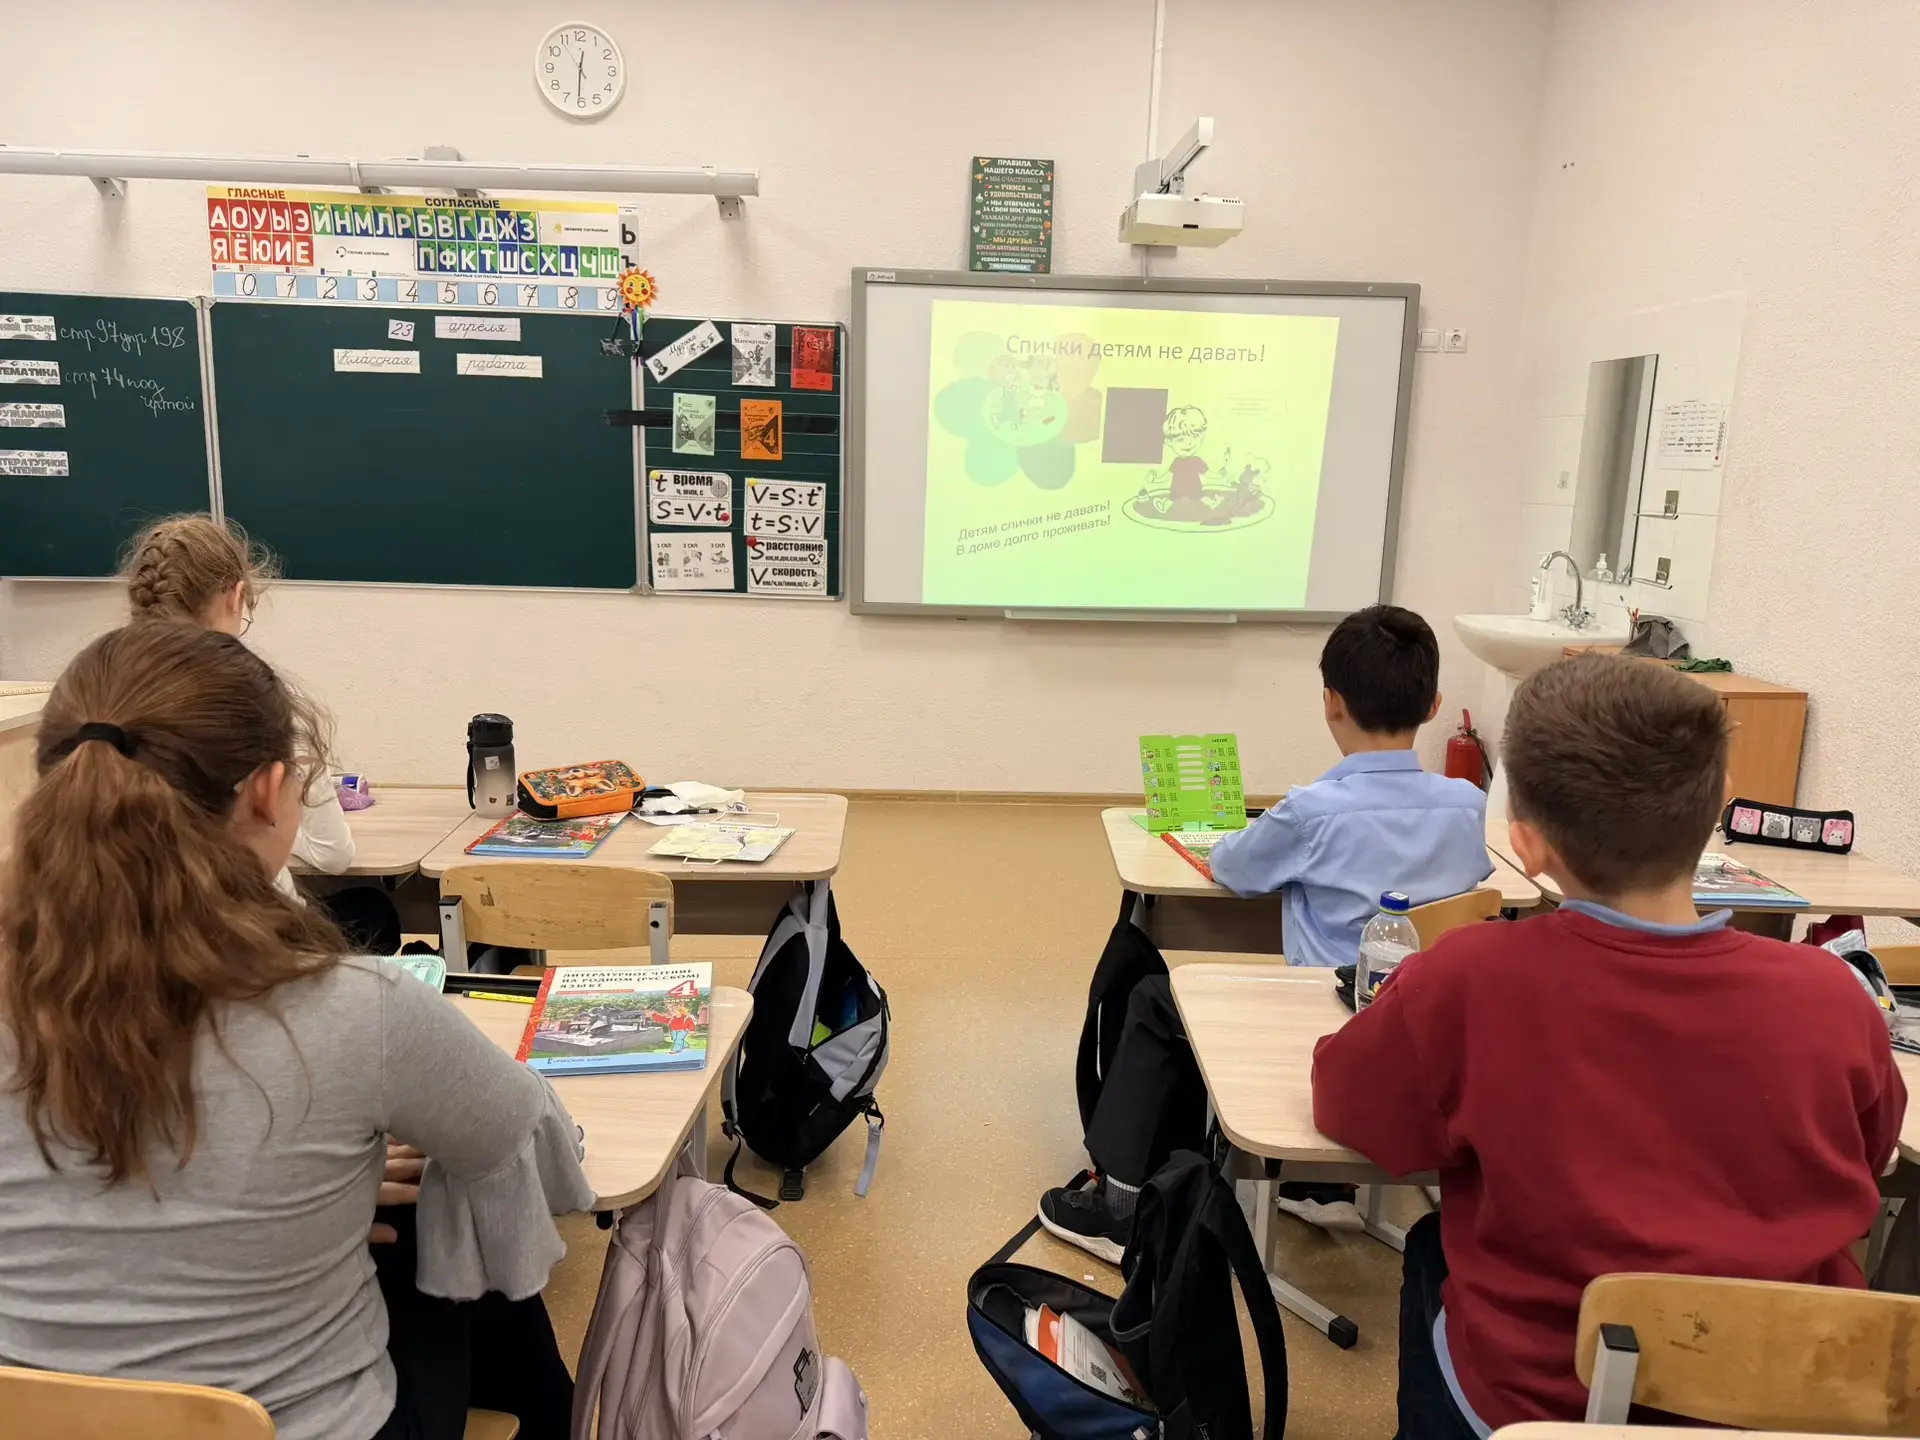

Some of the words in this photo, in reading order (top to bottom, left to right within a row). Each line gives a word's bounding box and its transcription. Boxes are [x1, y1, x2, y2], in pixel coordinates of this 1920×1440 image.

[560, 34, 569, 45] 11
[574, 31, 587, 42] 12
[593, 36, 598, 47] 1
[549, 46, 561, 57] 10
[603, 49, 612, 60] 2
[545, 63, 554, 73] 9
[607, 66, 617, 77] 3
[551, 80, 560, 90] 8
[603, 82, 612, 93] 4
[563, 92, 570, 103] 7
[577, 97, 586, 108] 6
[592, 94, 601, 105] 5
[997, 159, 1032, 167] ПРАВИЛА
[1015, 168, 1045, 176] КЛАССА
[227, 188, 286, 200] ГЛАСНЫЕ
[425, 197, 500, 209] СОГЛАСНЫЕ
[210, 205, 228, 228] А
[231, 207, 248, 229] О
[251, 207, 267, 230] У
[271, 208, 290, 231] Ы
[294, 209, 310, 232] Э
[313, 205, 331, 233] Й
[334, 211, 350, 233] Н
[354, 212, 373, 234] М
[375, 212, 394, 235] Л
[397, 213, 411, 235] Р
[417, 215, 433, 237] Б
[438, 215, 454, 238] В
[459, 216, 472, 238] Г
[478, 216, 497, 240] Д
[497, 217, 518, 240] Ж
[520, 218, 535, 241] З
[621, 223, 636, 245] Ь
[213, 237, 230, 260] Я
[234, 234, 248, 261] Ё
[252, 239, 271, 262] Ю
[275, 240, 291, 262] И
[296, 241, 310, 263] Е
[419, 247, 435, 269] П
[439, 247, 456, 270] Ф
[461, 249, 476, 271] К
[481, 250, 496, 271] Т
[500, 250, 518, 272] Ш
[520, 251, 535, 273] С
[540, 252, 557, 274] Х
[560, 252, 578, 277] Ц
[581, 253, 597, 275] Ч
[600, 253, 619, 278] Щ
[242, 273, 256, 296] 0
[287, 275, 297, 297] 1
[323, 277, 337, 299] 2
[362, 278, 378, 300] 3
[406, 280, 419, 302] 4
[442, 282, 457, 304] 5
[484, 283, 498, 305] 6
[523, 284, 538, 307] 7
[564, 286, 578, 309] 8
[604, 288, 618, 310] 9
[96, 318, 117, 343] 97
[150, 326, 186, 348] 198
[390, 322, 413, 337] 23
[669, 335, 697, 357] Музыка
[1006, 335, 1082, 357] Спички
[1088, 342, 1152, 359] детям
[1159, 345, 1183, 359] не
[1188, 344, 1265, 363] давать!
[758, 357, 773, 379] 4
[101, 367, 125, 389] 74
[698, 425, 713, 446] 4
[763, 428, 776, 447] 4
[673, 474, 714, 487] время
[957, 525, 998, 542] Детям
[1001, 514, 1043, 532] спички
[1046, 511, 1061, 522] не
[1063, 499, 1110, 521] давать!
[956, 545, 965, 556] В
[968, 539, 1001, 555] доме
[1003, 531, 1039, 548] долго
[1042, 514, 1111, 540] проживать!
[766, 541, 823, 552] расстояние
[750, 567, 769, 585] V
[772, 567, 817, 577] скорость
[636, 973, 700, 982] (РУССКОМ)
[667, 979, 699, 998] 4
